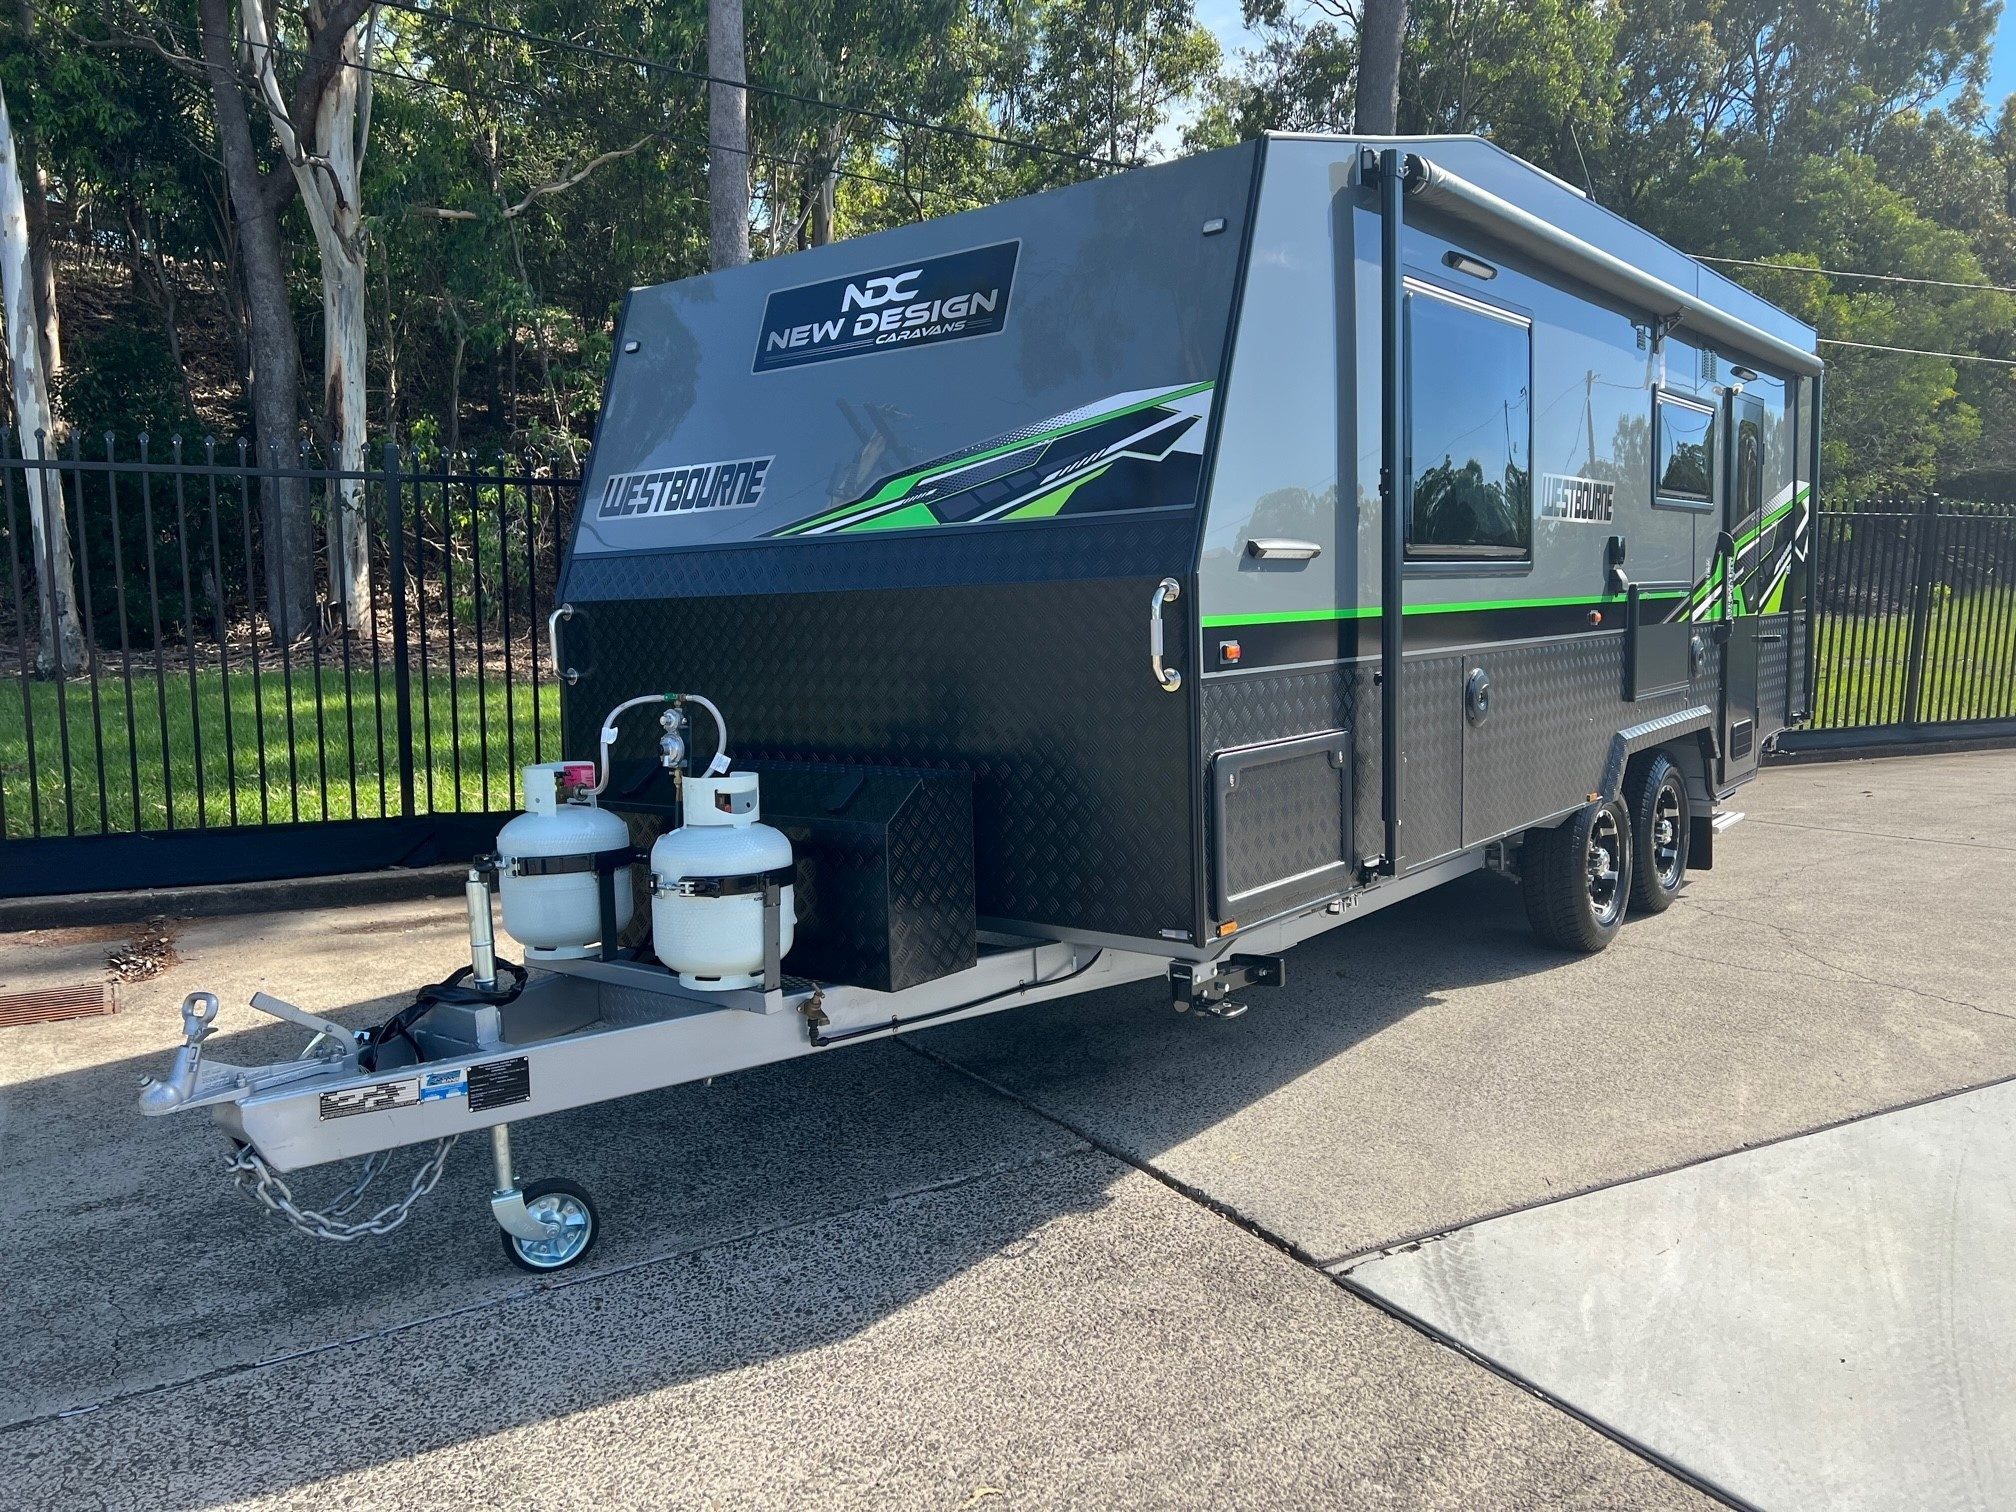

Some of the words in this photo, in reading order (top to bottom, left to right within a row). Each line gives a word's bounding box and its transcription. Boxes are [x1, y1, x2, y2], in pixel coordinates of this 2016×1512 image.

[840, 269, 924, 313] NDC
[766, 318, 846, 351] NEW
[852, 288, 999, 336] DESIGN
[875, 320, 967, 345] CARAVANS
[598, 458, 772, 519] WESTBOURNE
[1541, 476, 1614, 521] WESTBOURNE
